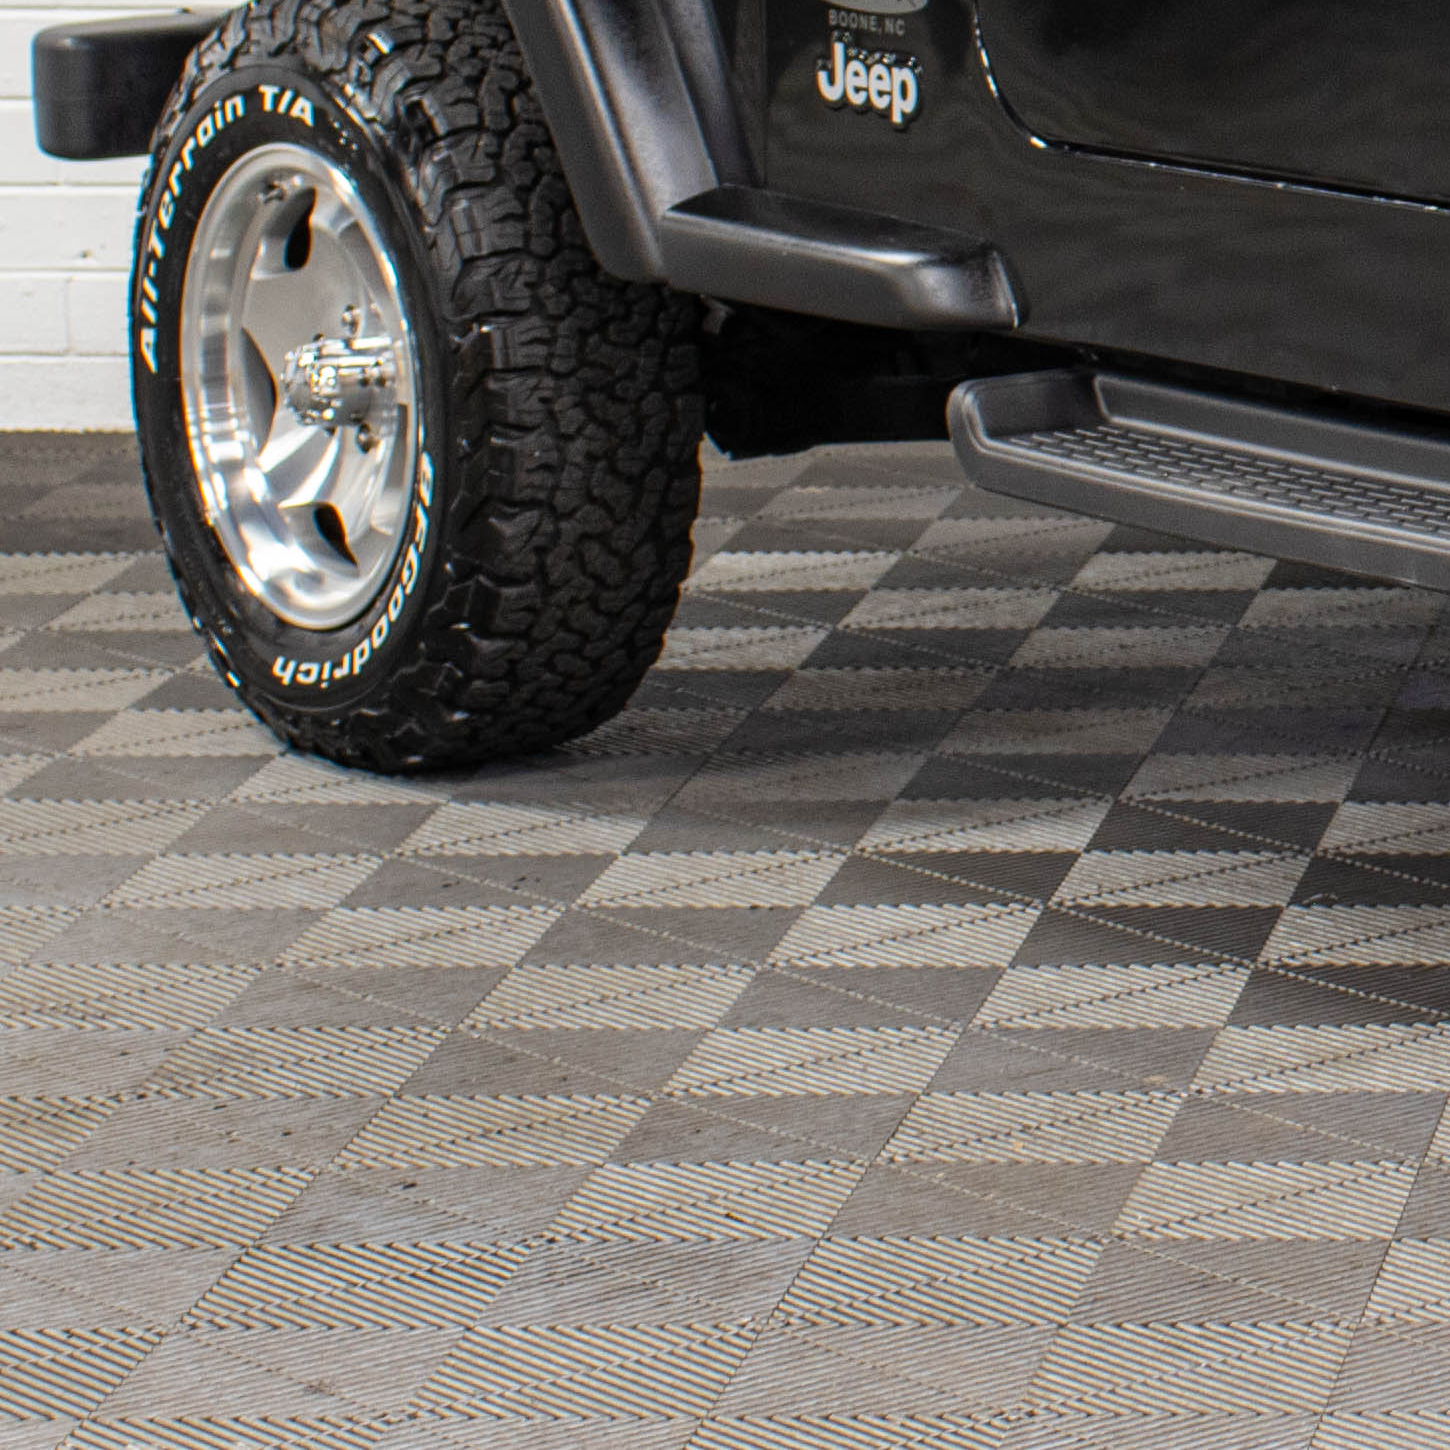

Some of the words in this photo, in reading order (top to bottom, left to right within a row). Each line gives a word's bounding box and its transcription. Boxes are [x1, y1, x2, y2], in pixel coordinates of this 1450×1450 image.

[817, 40, 918, 125] Jeep
[139, 96, 246, 374] All-Terrain
[258, 84, 314, 127] T/A
[272, 452, 435, 687] BFGoodrich
